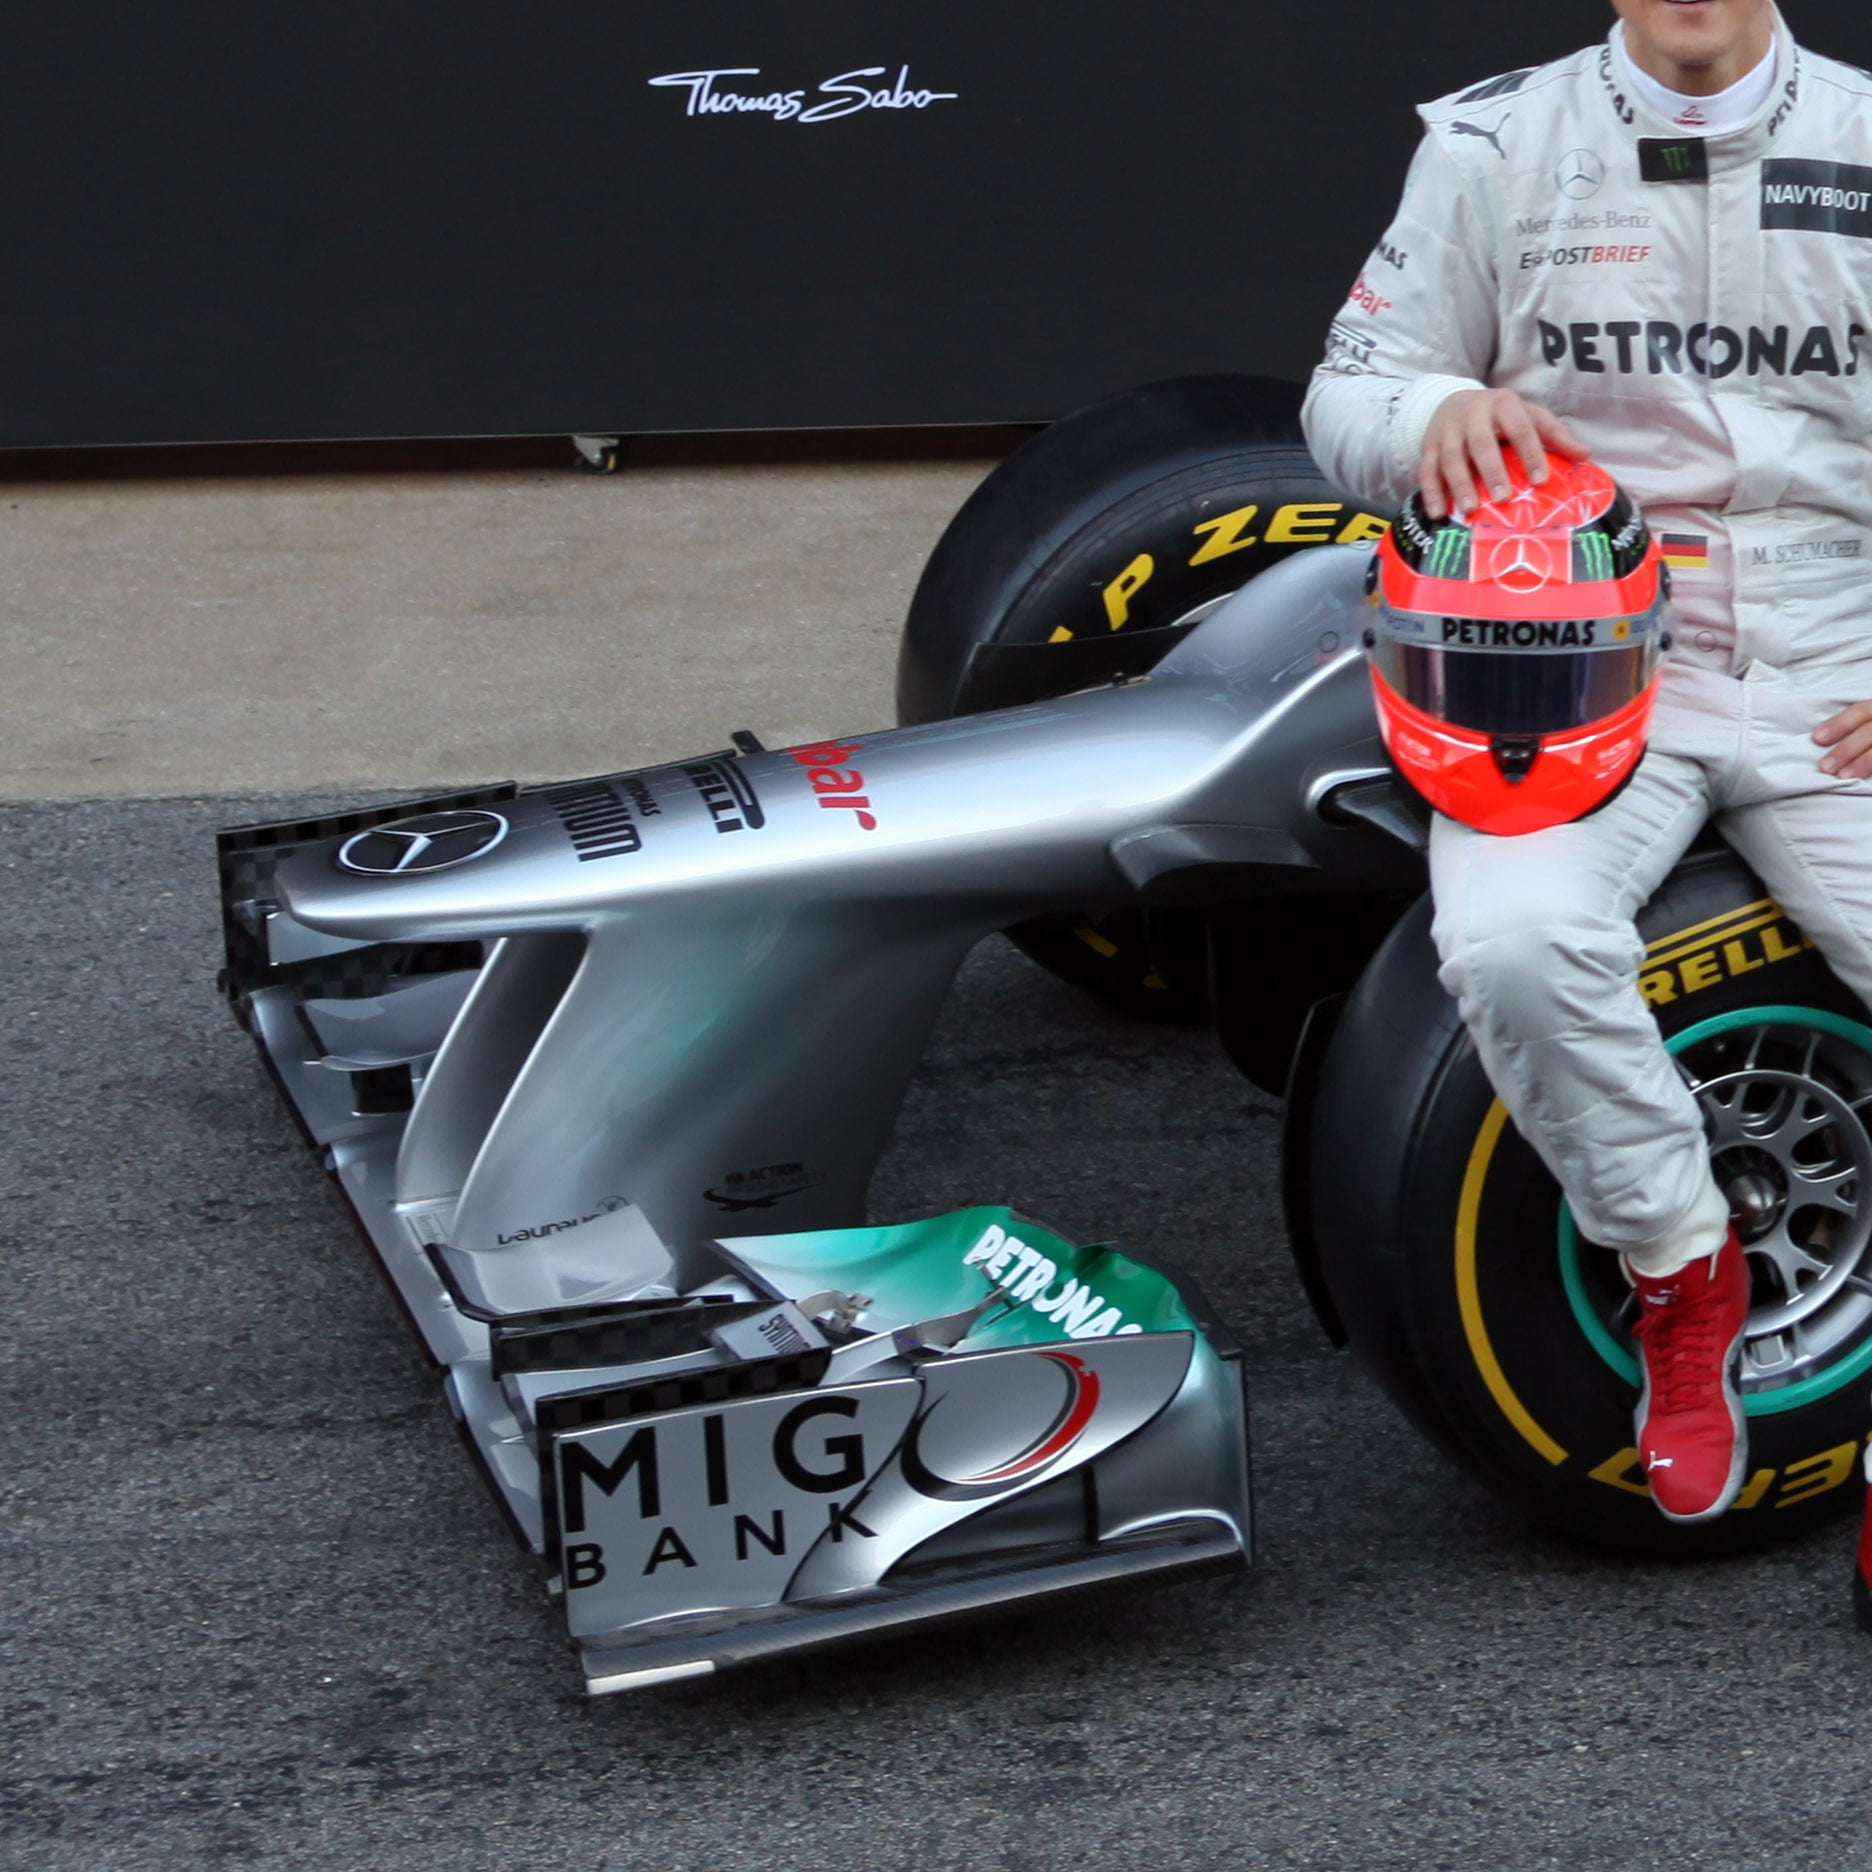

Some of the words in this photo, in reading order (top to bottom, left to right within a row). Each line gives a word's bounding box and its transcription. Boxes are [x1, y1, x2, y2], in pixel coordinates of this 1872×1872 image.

[647, 68, 804, 121] Thomas
[801, 64, 958, 123] Sabo
[1765, 183, 1871, 212] NAVYBOOT
[1538, 319, 1864, 379] PETRONAS
[1103, 553, 1154, 631] P
[1189, 503, 1392, 567] ZER
[1441, 618, 1595, 646] PETRONAS
[786, 740, 877, 831] bar
[1636, 897, 1815, 1008] RELL
[963, 1224, 1143, 1339] PETRONA
[560, 1395, 866, 1533] MIG
[565, 1489, 879, 1590] BANK
